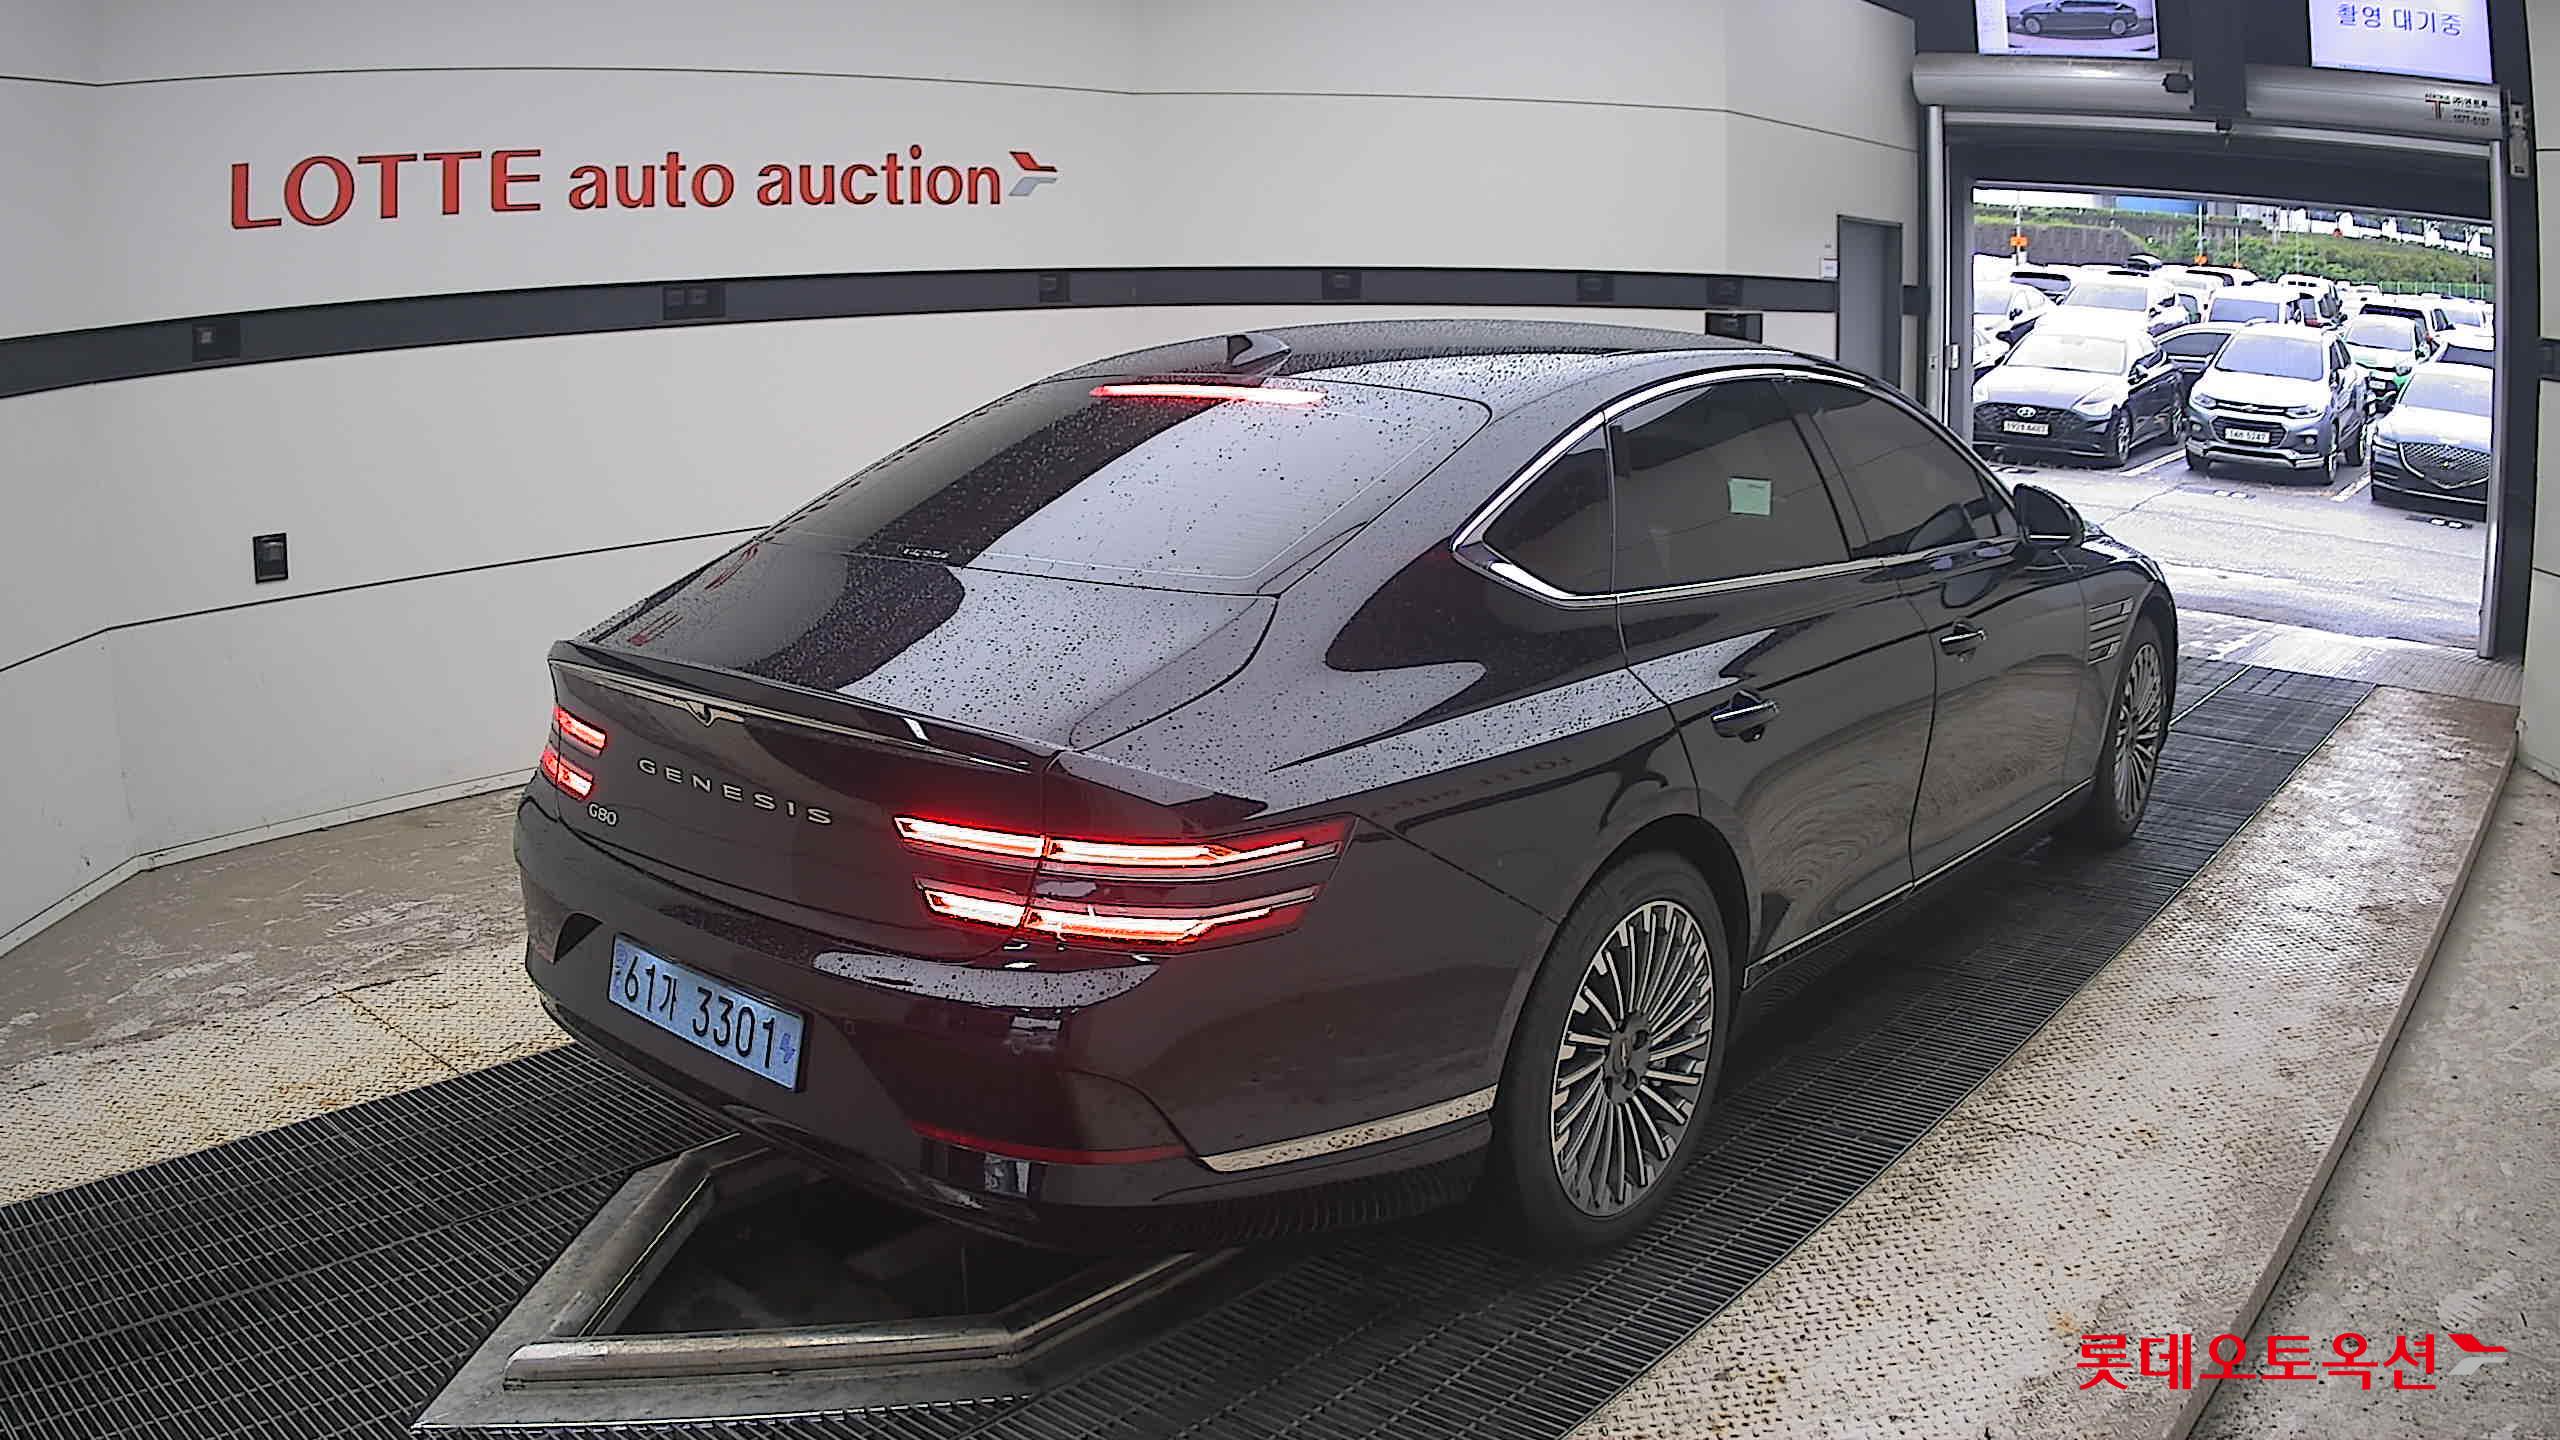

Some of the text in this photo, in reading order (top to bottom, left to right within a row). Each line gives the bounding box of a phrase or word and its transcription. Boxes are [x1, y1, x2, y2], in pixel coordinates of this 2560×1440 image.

[2338, 3, 2461, 36] 촬영 대기중
[231, 145, 1002, 229] LOTTE auto auction
[588, 802, 618, 826] G80
[638, 758, 832, 825] GENESIS
[625, 956, 776, 1069] 61가 3301
